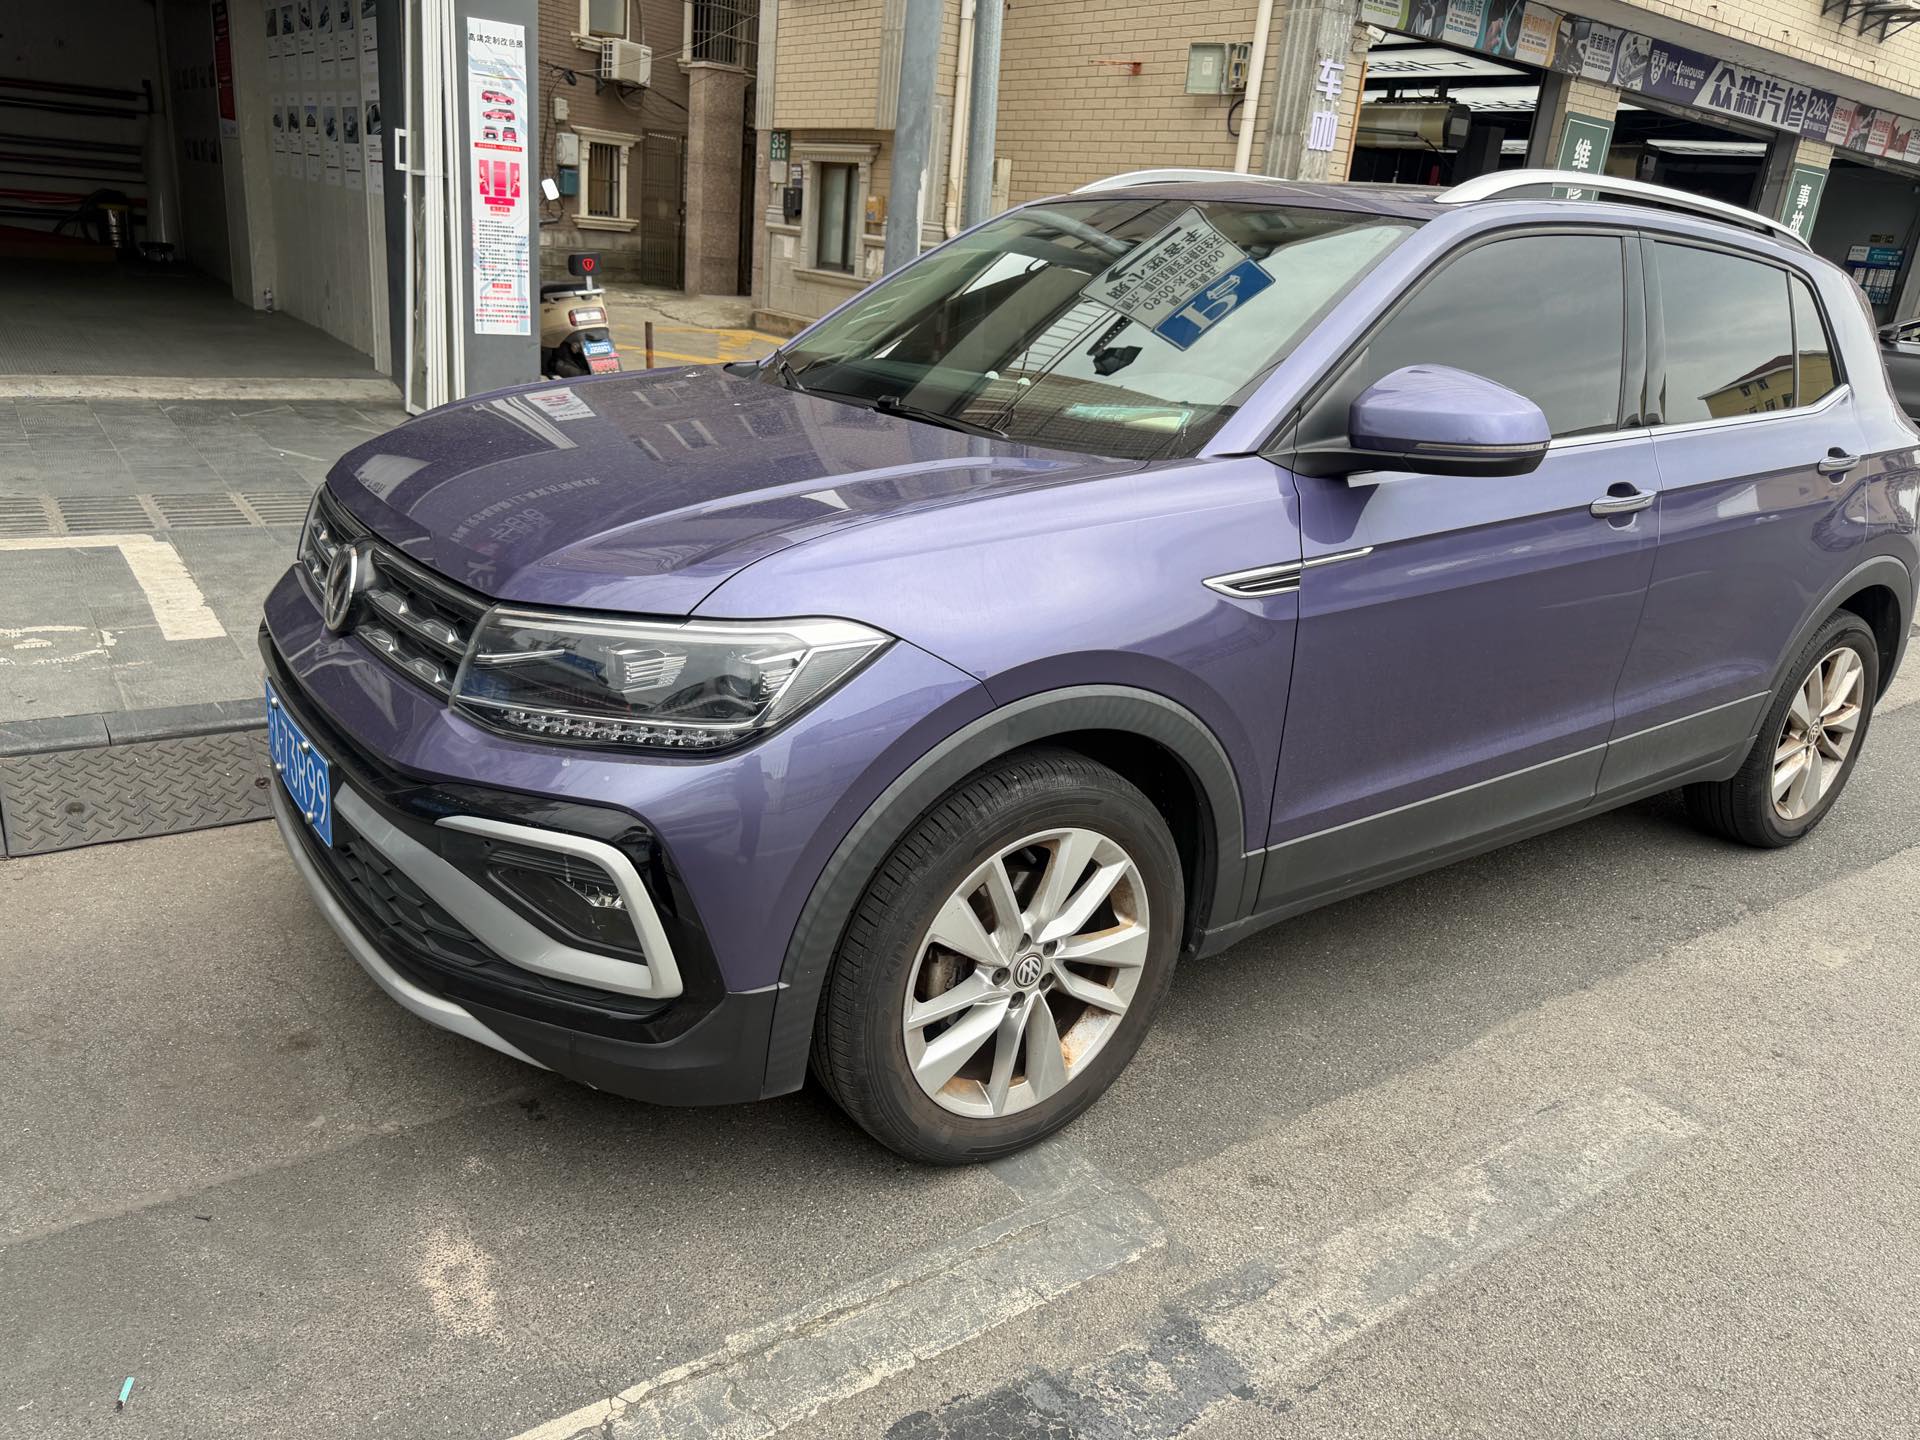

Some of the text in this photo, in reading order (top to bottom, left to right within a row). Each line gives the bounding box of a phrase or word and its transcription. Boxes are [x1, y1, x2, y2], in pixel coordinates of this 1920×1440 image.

[1708, 67, 1807, 128] 众森汽修
[772, 133, 787, 149] 35
